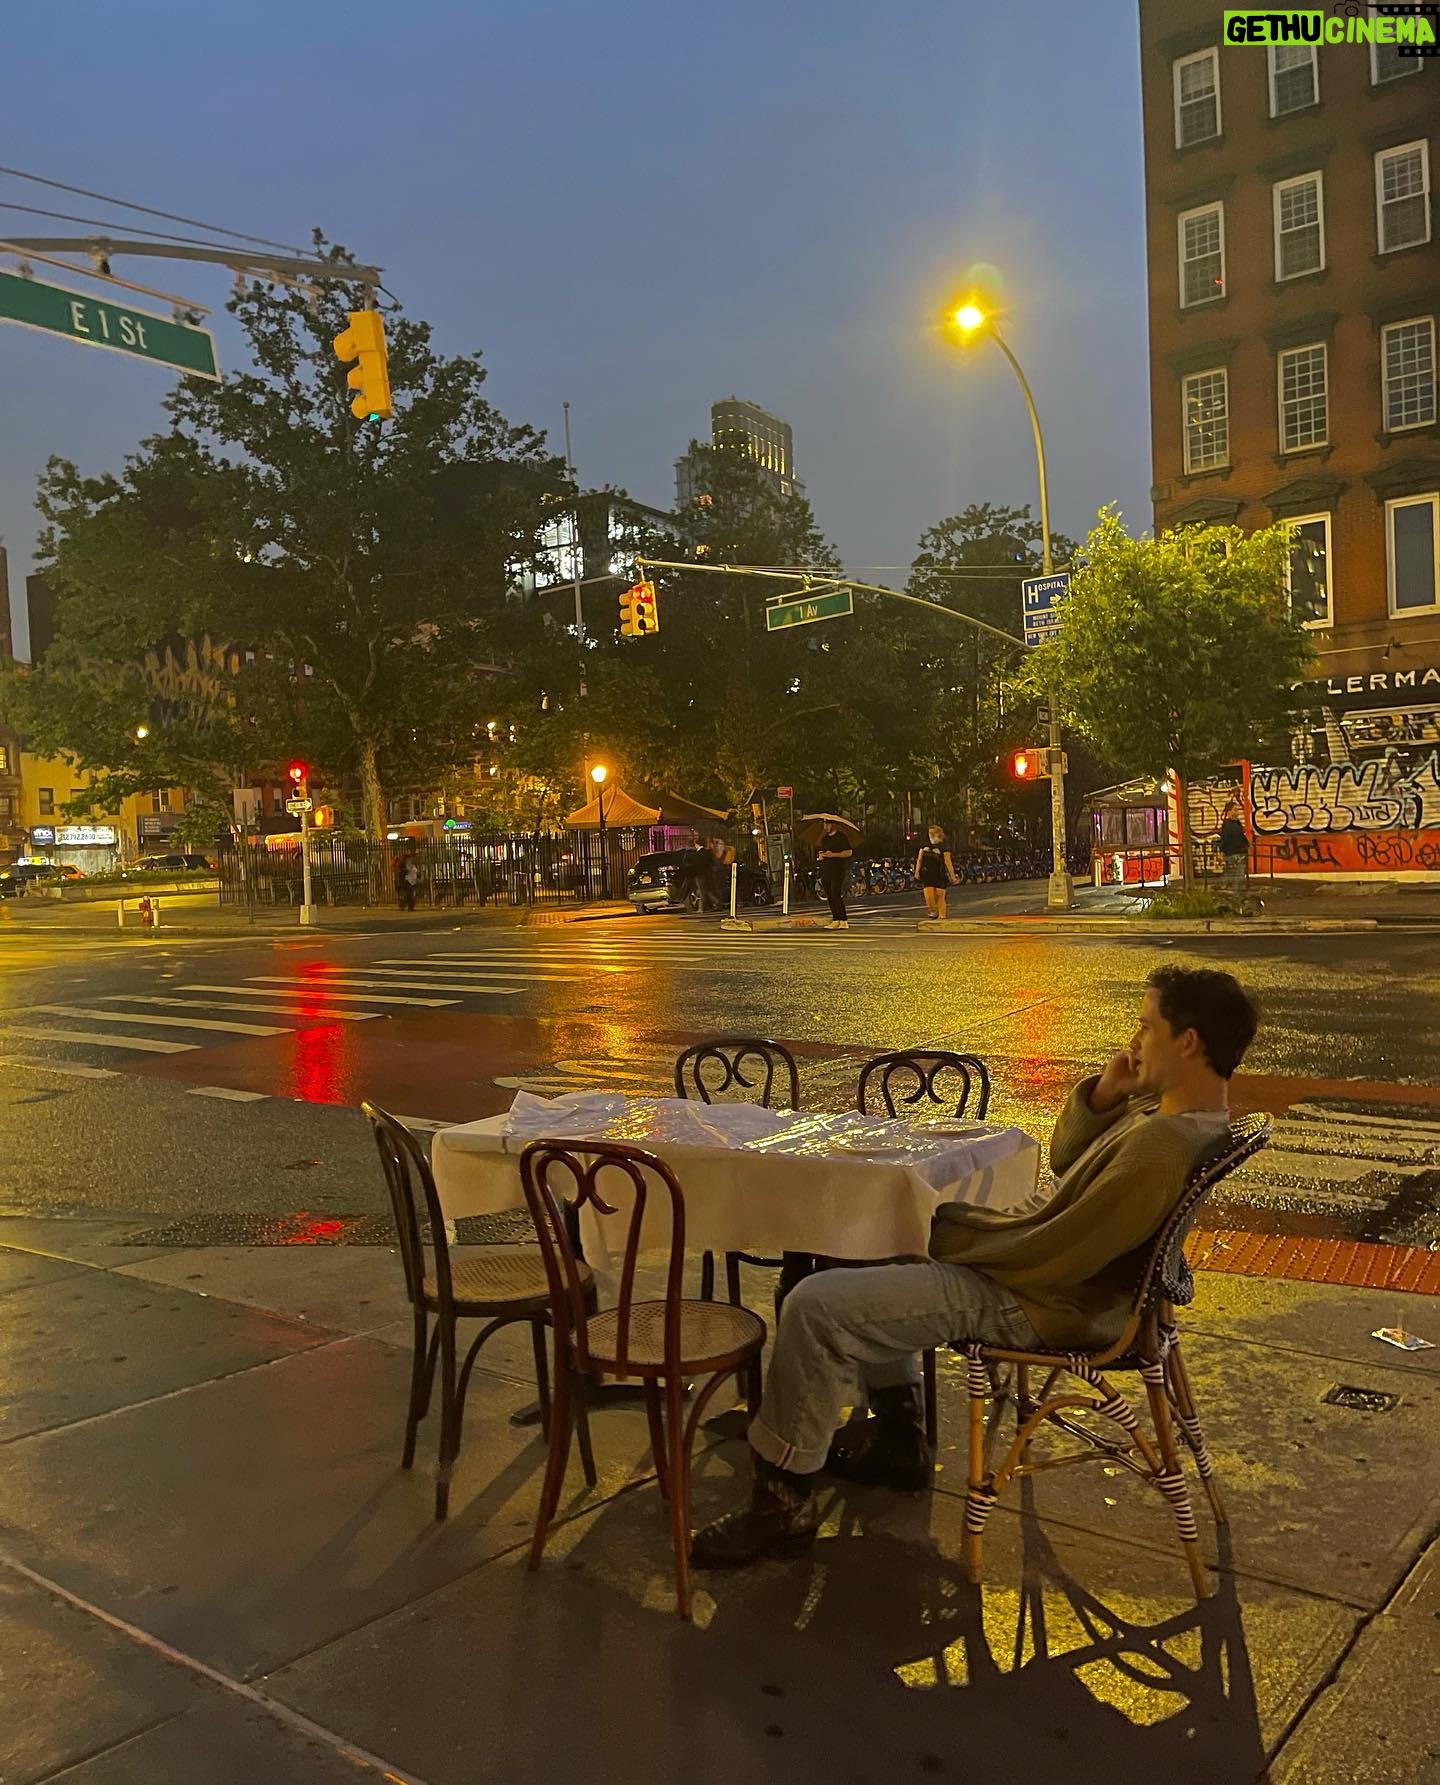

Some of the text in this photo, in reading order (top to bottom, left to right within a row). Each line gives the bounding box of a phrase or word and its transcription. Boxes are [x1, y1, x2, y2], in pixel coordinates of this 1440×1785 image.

[69, 300, 148, 349] E 1 St
[799, 606, 804, 619] 1
[1290, 668, 1440, 695] LERMA
